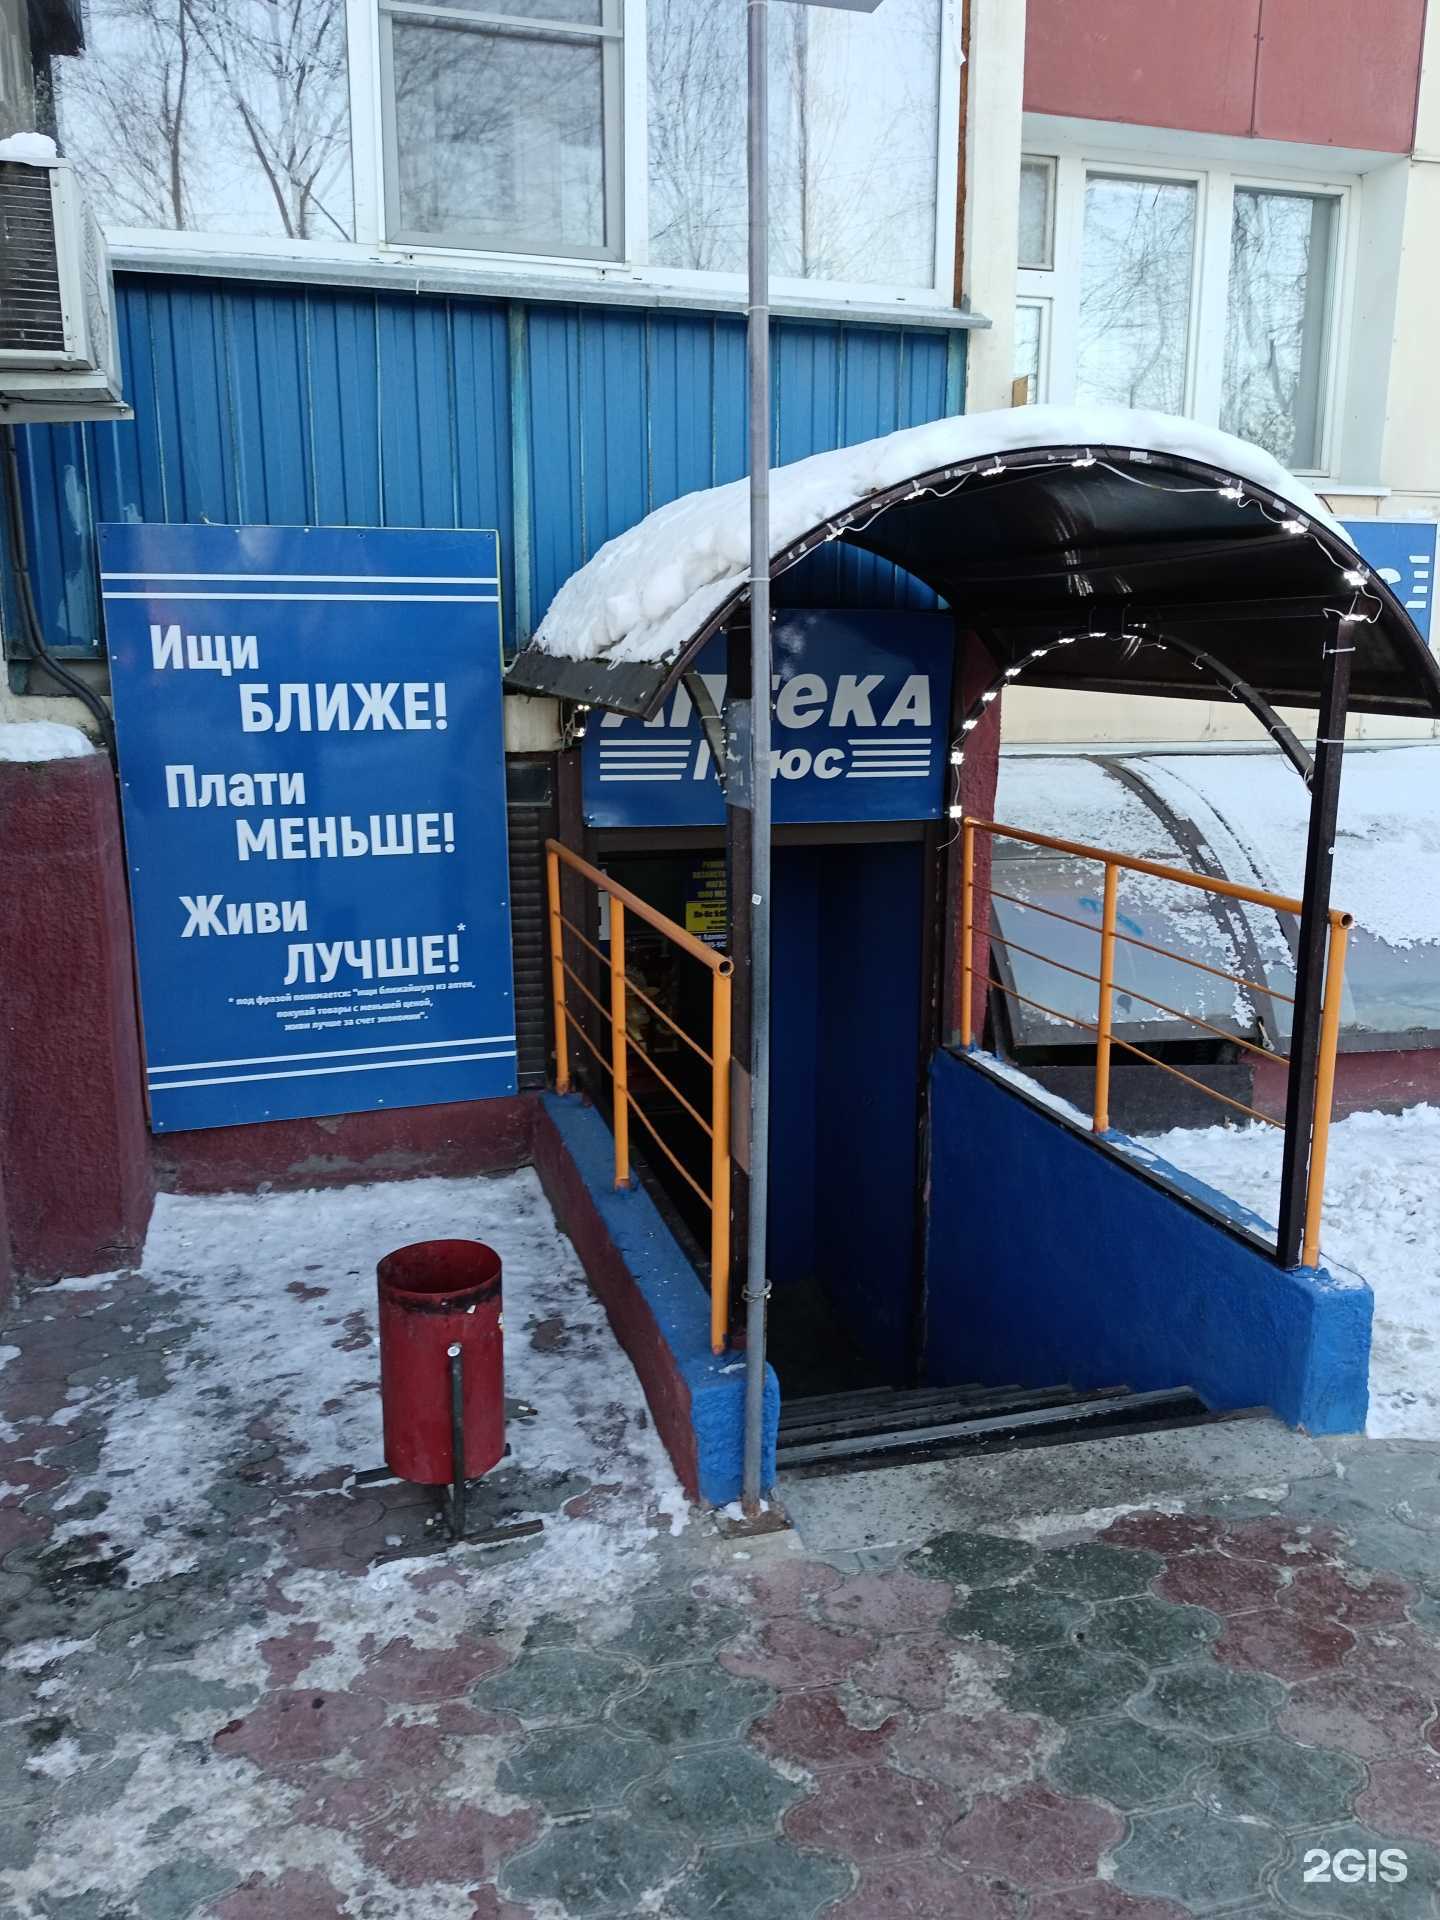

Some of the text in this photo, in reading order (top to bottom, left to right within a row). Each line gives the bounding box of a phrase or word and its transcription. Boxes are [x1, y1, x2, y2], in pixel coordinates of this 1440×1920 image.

[149, 625, 259, 677] Ищи
[239, 682, 448, 732] БЛИЖЕ!
[165, 764, 307, 809] Плати
[235, 811, 456, 862] МЕНЬШЕ!
[178, 893, 308, 938] Живи
